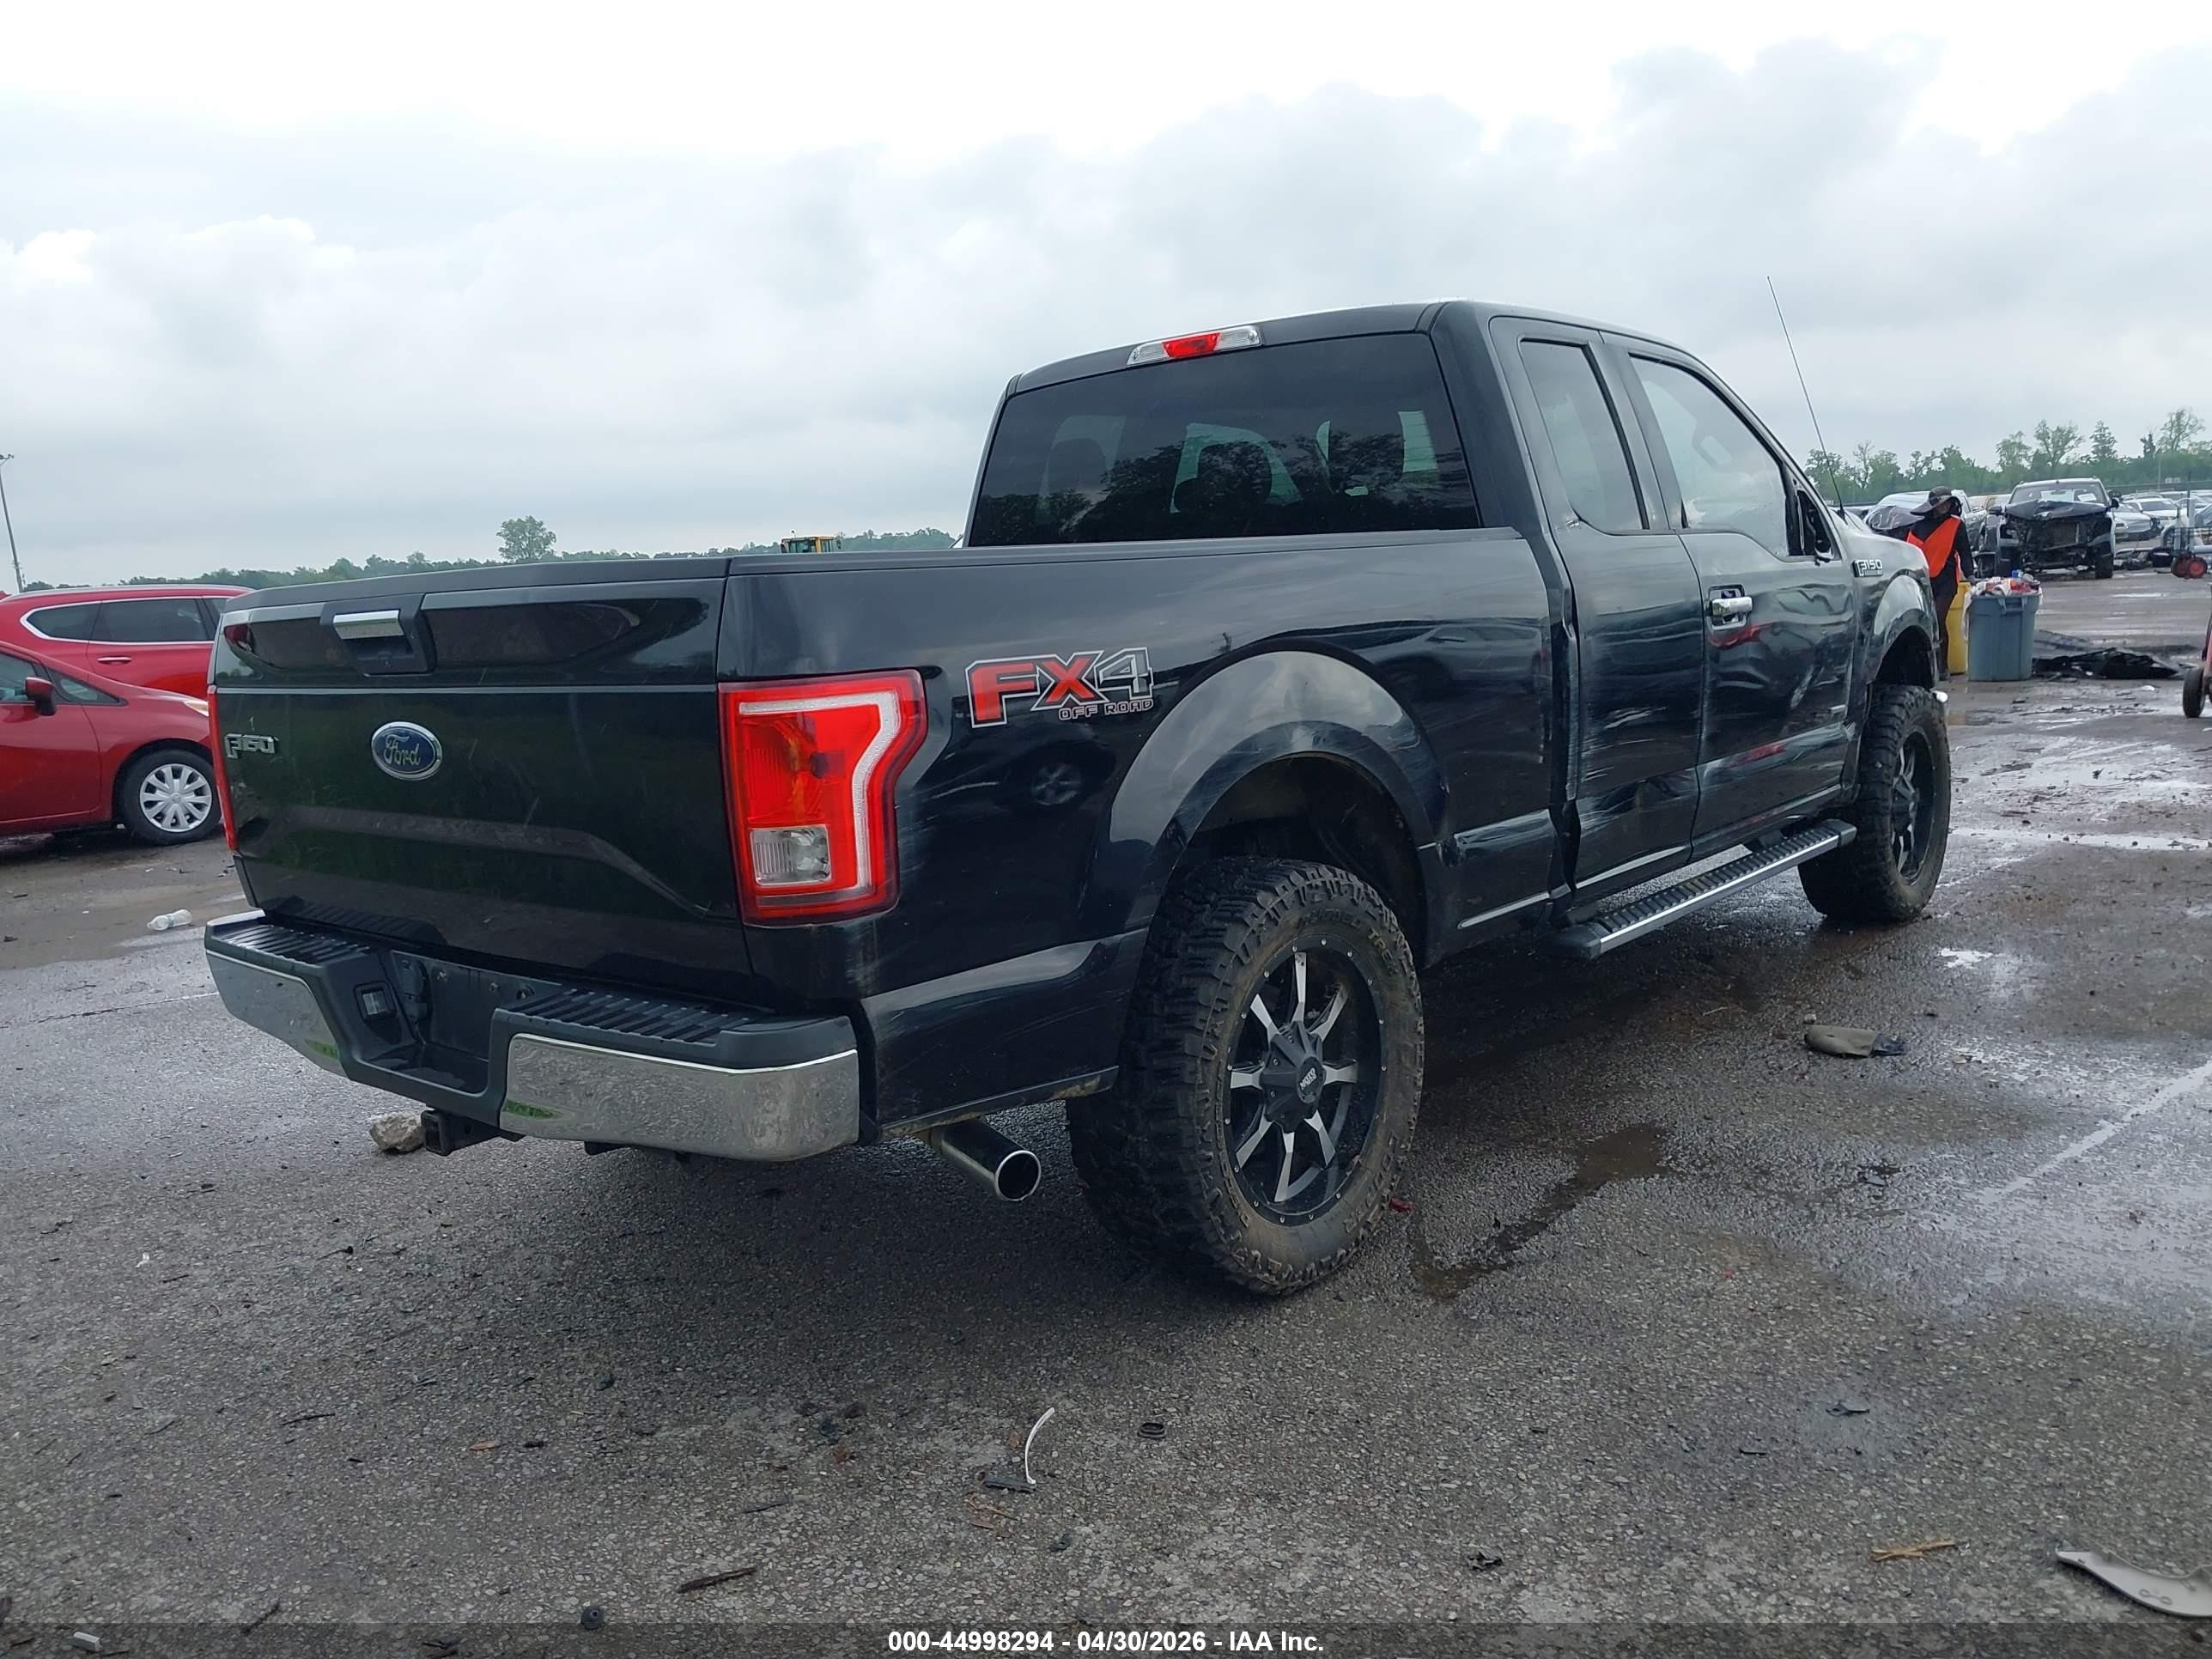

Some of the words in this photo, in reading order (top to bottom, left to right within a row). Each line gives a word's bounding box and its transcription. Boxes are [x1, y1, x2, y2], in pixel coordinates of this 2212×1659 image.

[965, 647, 1154, 728] FX4
[1058, 704, 1099, 721] OFF
[1103, 698, 1154, 716] ROAD
[383, 734, 421, 767] Ford
